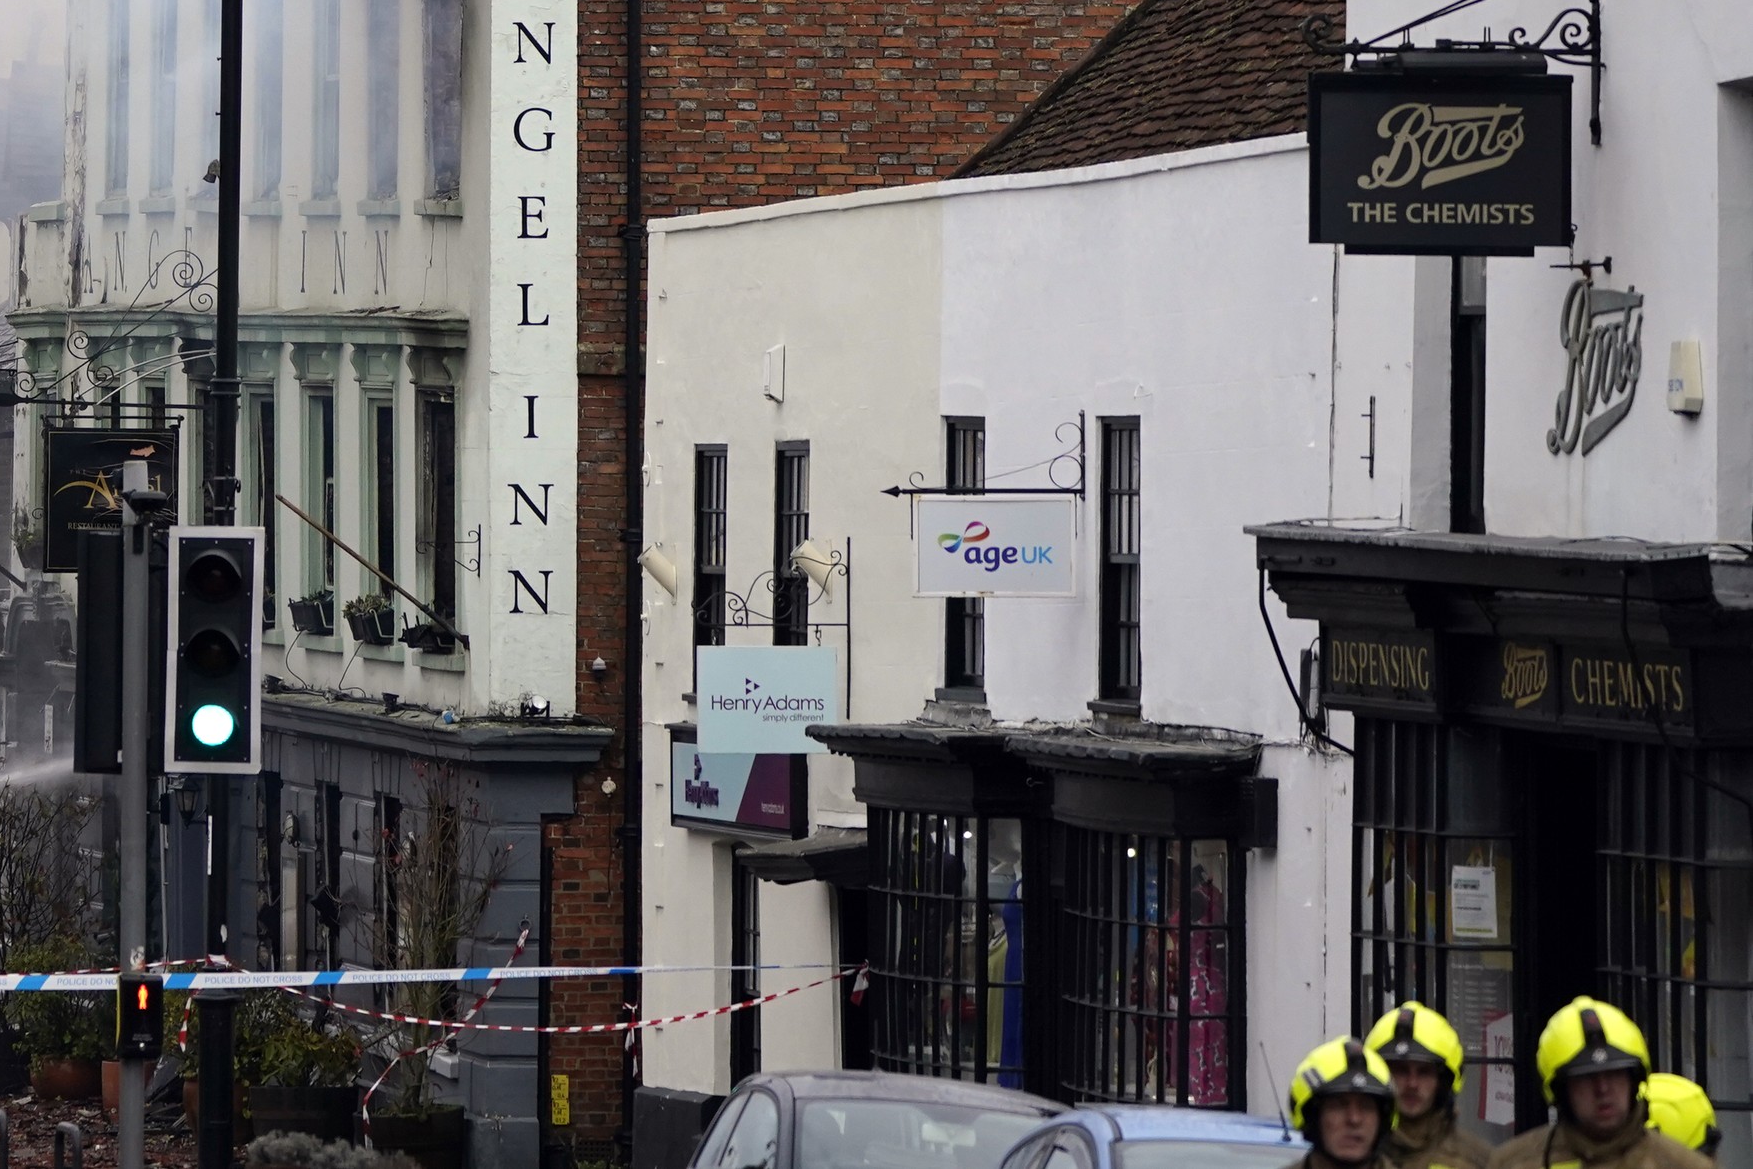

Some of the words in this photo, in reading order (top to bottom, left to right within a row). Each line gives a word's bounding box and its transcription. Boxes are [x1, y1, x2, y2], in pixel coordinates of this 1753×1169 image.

[1357, 102, 1524, 190] Boots
[1347, 202, 1397, 224] THE
[1405, 203, 1535, 225] CHEMISTS
[299, 230, 386, 295] INN
[1546, 278, 1644, 457] Boots
[508, 395, 555, 615] INN
[67, 521, 120, 531] RESTAURANT
[963, 546, 1018, 573] age
[1020, 544, 1054, 565] UK
[1331, 640, 1430, 691] DISPENSING
[1501, 641, 1547, 709] Boots
[1569, 657, 1683, 713] CHEMISTS
[711, 695, 762, 714] Henry
[763, 695, 825, 711] Adams
[762, 713, 788, 723] simply
[789, 712, 824, 723] different
[56, 977, 88, 986] POLICE
[90, 977, 103, 986] DO
[105, 976, 117, 985] NO
[203, 976, 235, 985] POLICE
[237, 976, 250, 984] DO
[252, 975, 270, 984] NOT
[272, 975, 303, 984] CROSS
[352, 973, 383, 982] POLICE
[385, 972, 398, 981] DO
[401, 972, 419, 981] NOT
[421, 971, 452, 980] CROSS
